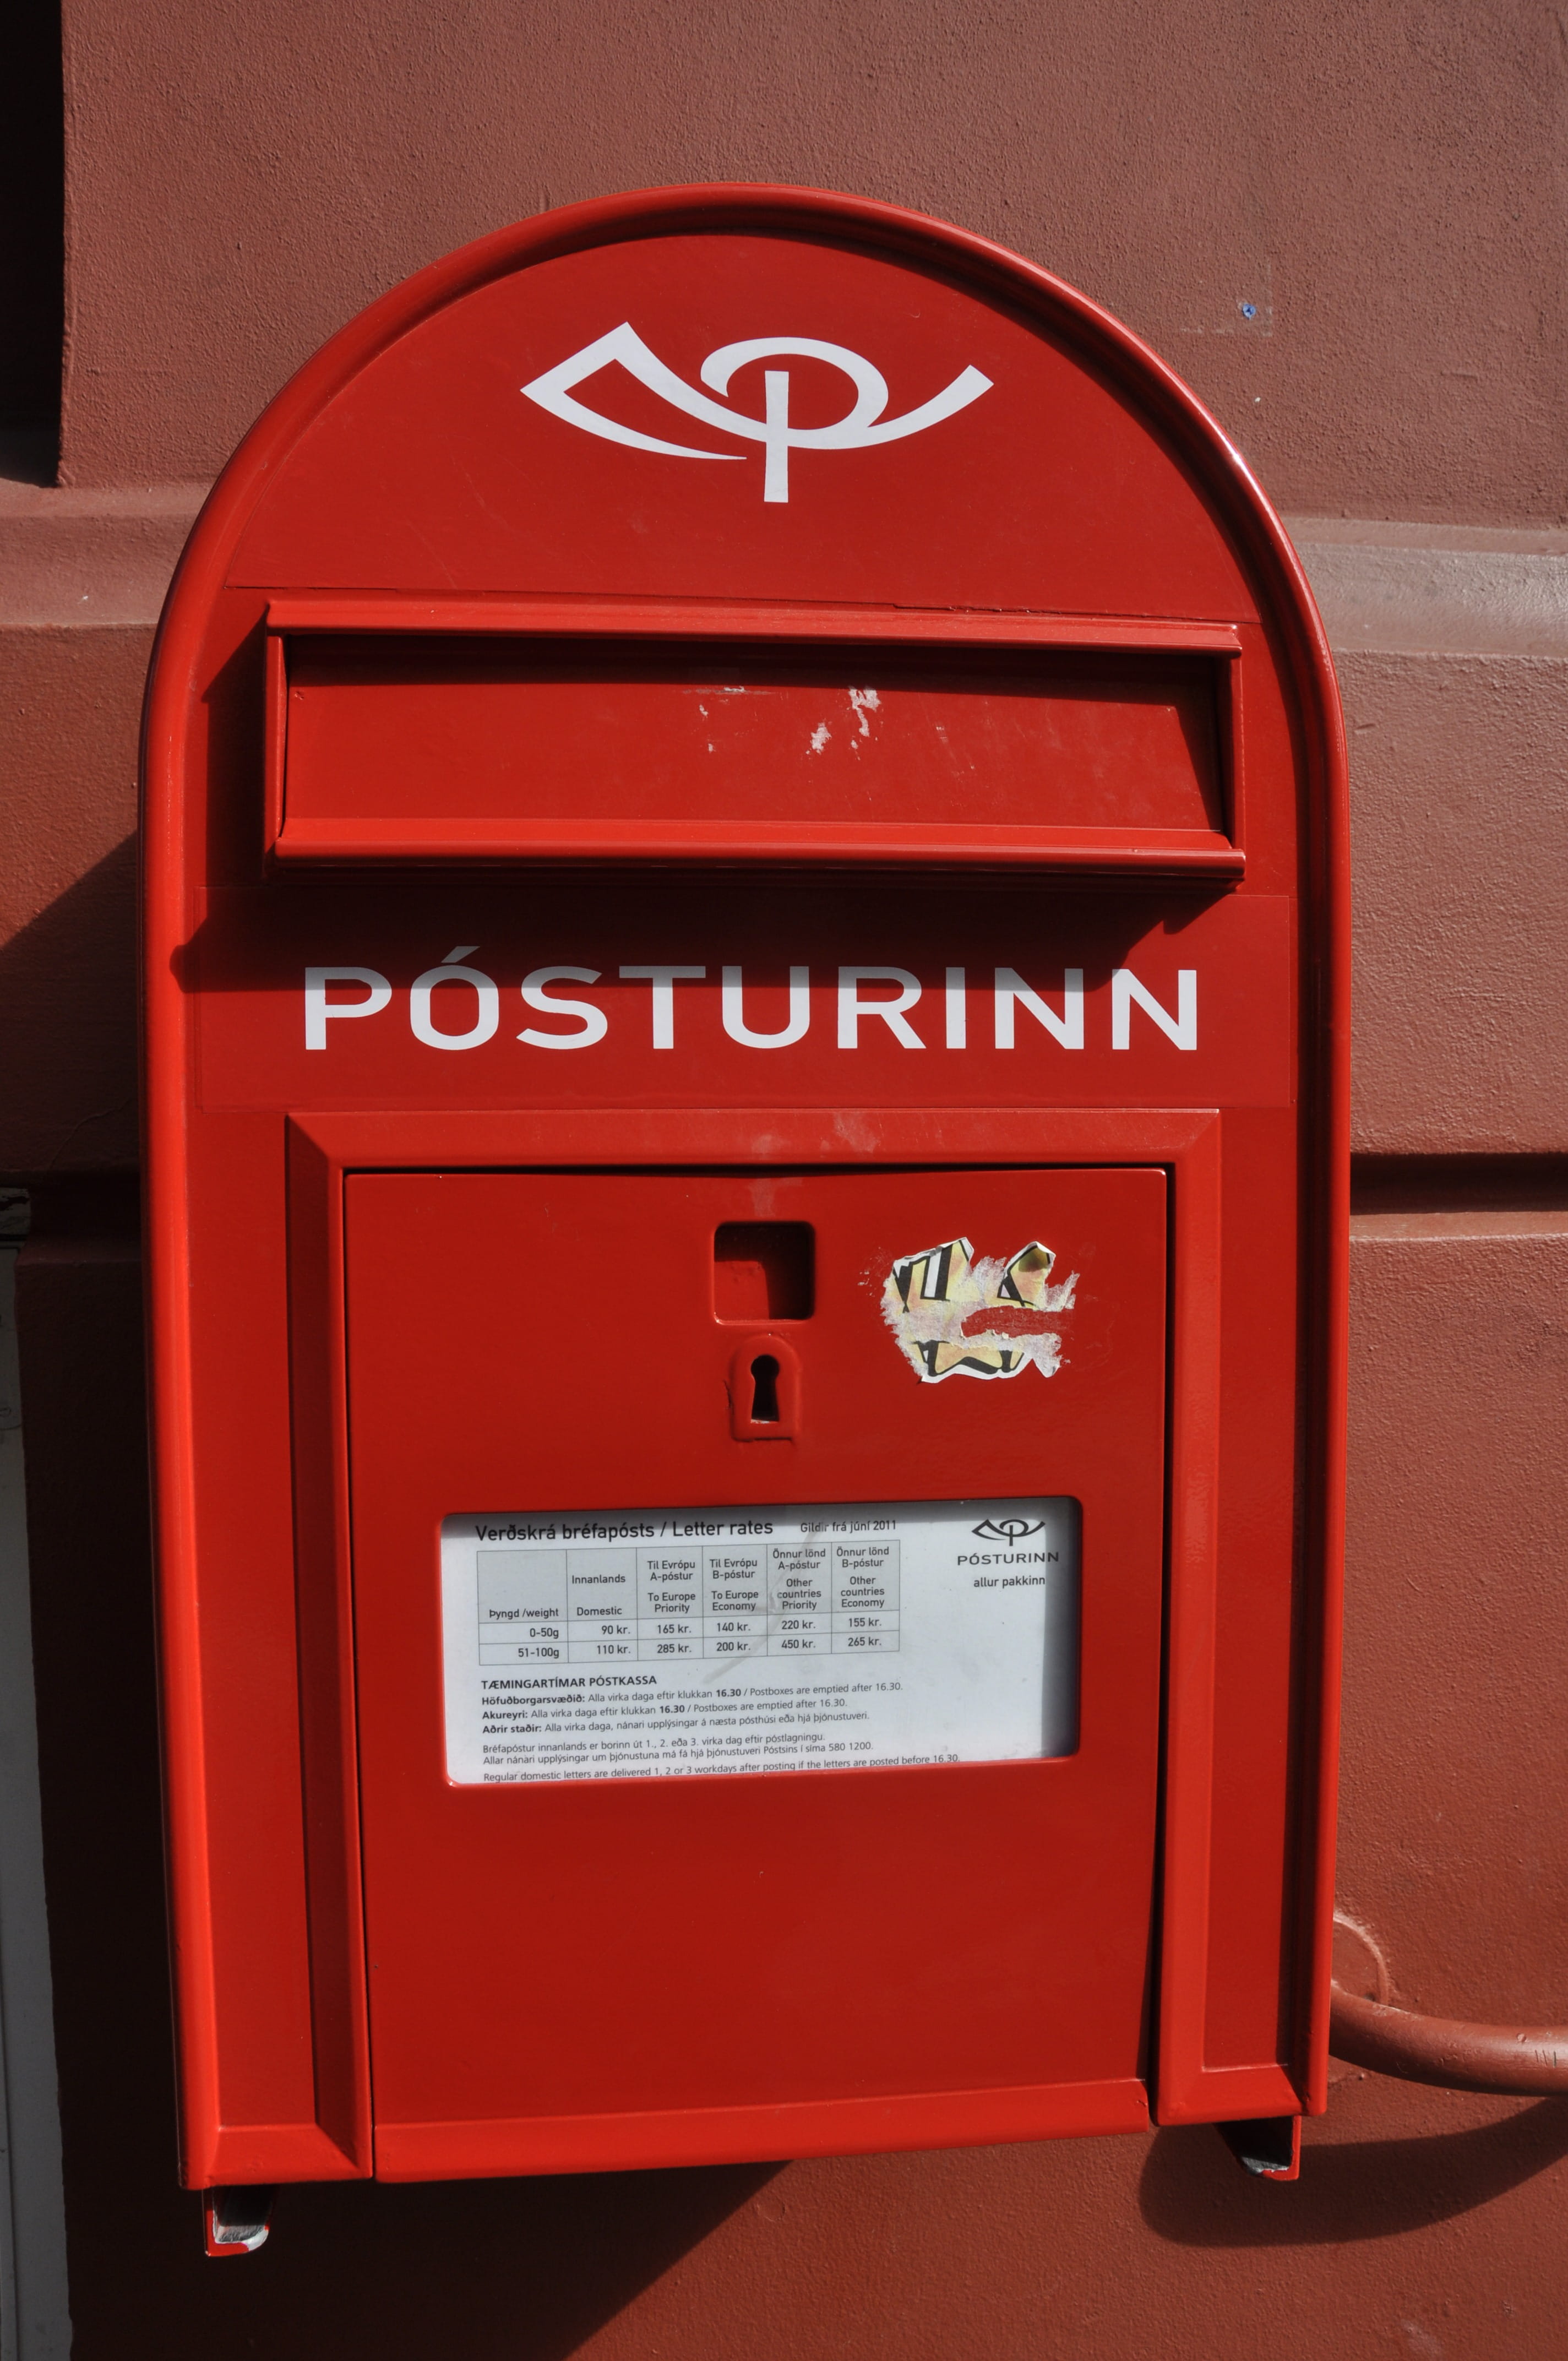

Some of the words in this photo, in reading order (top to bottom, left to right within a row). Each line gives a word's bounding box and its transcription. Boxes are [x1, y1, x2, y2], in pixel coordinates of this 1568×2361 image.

[305, 946, 1197, 1050] PÓSTURINN
[832, 1521, 847, 1531] frá
[873, 1520, 896, 1530] 2011
[476, 1525, 556, 1541] Verðskrá
[563, 1523, 654, 1542] bréfapósts
[660, 1522, 666, 1537] /
[673, 1522, 724, 1536] Letter
[730, 1521, 773, 1535] rates
[773, 1548, 803, 1558] Önnur
[805, 1548, 826, 1557] lönd
[837, 1546, 866, 1557] Önnur
[869, 1546, 889, 1555] lönd
[709, 1559, 721, 1568] Til
[724, 1558, 757, 1570] Evrópu
[842, 1558, 884, 1569] B-póstur
[957, 1552, 1059, 1565] PÓSTURINN
[647, 1560, 659, 1569] Til
[662, 1560, 695, 1571] Evrópu
[778, 1560, 820, 1571] A-póstur
[572, 1574, 625, 1584] Innanlands
[650, 1570, 693, 1582] A-póstur
[712, 1569, 755, 1581] B-póstur
[850, 1576, 876, 1585] Other
[786, 1578, 813, 1587] Other
[973, 1577, 999, 1587] allur
[1003, 1575, 1045, 1589] pakkinn
[711, 1591, 722, 1600] To
[726, 1590, 759, 1601] Europe
[777, 1589, 821, 1598] countries
[841, 1587, 884, 1596] countries
[647, 1592, 660, 1601] To
[662, 1592, 696, 1604] Europe
[841, 1599, 884, 1608] Economy
[577, 1606, 622, 1615] Domestic
[655, 1602, 690, 1614] Priority
[712, 1601, 756, 1612] Economy
[782, 1600, 817, 1611] Priority
[489, 1609, 519, 1620] Þyngd
[522, 1608, 558, 1619] /weight
[717, 1622, 734, 1632] 140
[737, 1622, 750, 1631] kr.
[782, 1620, 799, 1630] 220
[802, 1620, 815, 1629] kr.
[849, 1618, 865, 1627] 155
[869, 1618, 881, 1626] kr.
[530, 1628, 558, 1639] 0-50g
[601, 1625, 613, 1634] 90
[617, 1625, 630, 1634] kr.
[657, 1624, 674, 1634] 165
[678, 1624, 691, 1633] kr.
[717, 1642, 734, 1651] 200
[737, 1641, 750, 1651] kr.
[781, 1640, 799, 1649] 450
[803, 1639, 815, 1649] kr.
[848, 1637, 865, 1646] 265
[869, 1636, 881, 1645] kr.
[519, 1647, 559, 1658] 51-100g
[597, 1645, 614, 1654] 110
[617, 1645, 630, 1653] kr.
[657, 1644, 675, 1653] 285
[678, 1644, 692, 1652] kr.
[481, 1677, 585, 1689] TÆMINGARTÍMAR
[590, 1675, 657, 1686] PÓSTKASSA
[482, 1694, 585, 1706] Höfuðborgarsvæðið:
[588, 1694, 605, 1702] Alla
[608, 1693, 629, 1701] virka
[632, 1693, 654, 1702] daga
[657, 1691, 675, 1700] eftir
[716, 1689, 741, 1697] 16.30
[750, 1687, 793, 1696] Postboxes
[813, 1684, 848, 1695] emptied
[852, 1683, 872, 1692] after
[482, 1710, 527, 1721] Akureyri:
[531, 1710, 547, 1718] Alla
[551, 1709, 571, 1717] virka
[575, 1708, 597, 1718] daga
[600, 1707, 618, 1716] eftir
[621, 1706, 655, 1715] klukkan
[660, 1705, 685, 1713] 16.30
[694, 1704, 737, 1712] Postboxes
[757, 1700, 793, 1711] emptied
[796, 1699, 816, 1708] after
[820, 1699, 847, 1707] 16.30.
[482, 1724, 508, 1733] Aðrir
[511, 1724, 541, 1733] staðir:
[564, 1722, 585, 1731] virka
[589, 1722, 613, 1732] daga,
[617, 1721, 644, 1729] nánari
[647, 1719, 698, 1730] upplýsingar
[739, 1715, 775, 1726] pósthúsi
[778, 1713, 794, 1722] eða
[798, 1713, 810, 1724] hjá
[483, 1744, 535, 1754] Bréfapóstur
[538, 1742, 587, 1751] innanlands
[601, 1741, 630, 1749] borinn
[660, 1739, 668, 1747] 2.
[672, 1738, 687, 1747] eða
[691, 1738, 698, 1746] 3.
[702, 1737, 722, 1745] virka
[726, 1736, 742, 1746] dag
[745, 1734, 763, 1743] eftir
[766, 1733, 825, 1744] póstlagningu.
[483, 1756, 504, 1764] Allar
[507, 1753, 535, 1764] nánari
[538, 1754, 589, 1765] upplýsingar
[609, 1750, 660, 1762] þjónustuna
[663, 1750, 676, 1758] má
[679, 1749, 687, 1758] fá
[691, 1749, 704, 1759] hjá
[707, 1745, 760, 1759] þjónustuveri
[764, 1745, 797, 1754] Póstsins
[829, 1743, 845, 1751] 580
[850, 1742, 873, 1750] 1200.
[483, 1773, 517, 1782] Regular
[520, 1771, 560, 1780] domestic
[611, 1767, 651, 1777] delivered
[695, 1764, 737, 1774] workdays
[740, 1763, 760, 1771] after
[798, 1760, 804, 1769] if
[807, 1760, 821, 1769] the
[870, 1756, 899, 1765] posted
[902, 1755, 929, 1764] before
